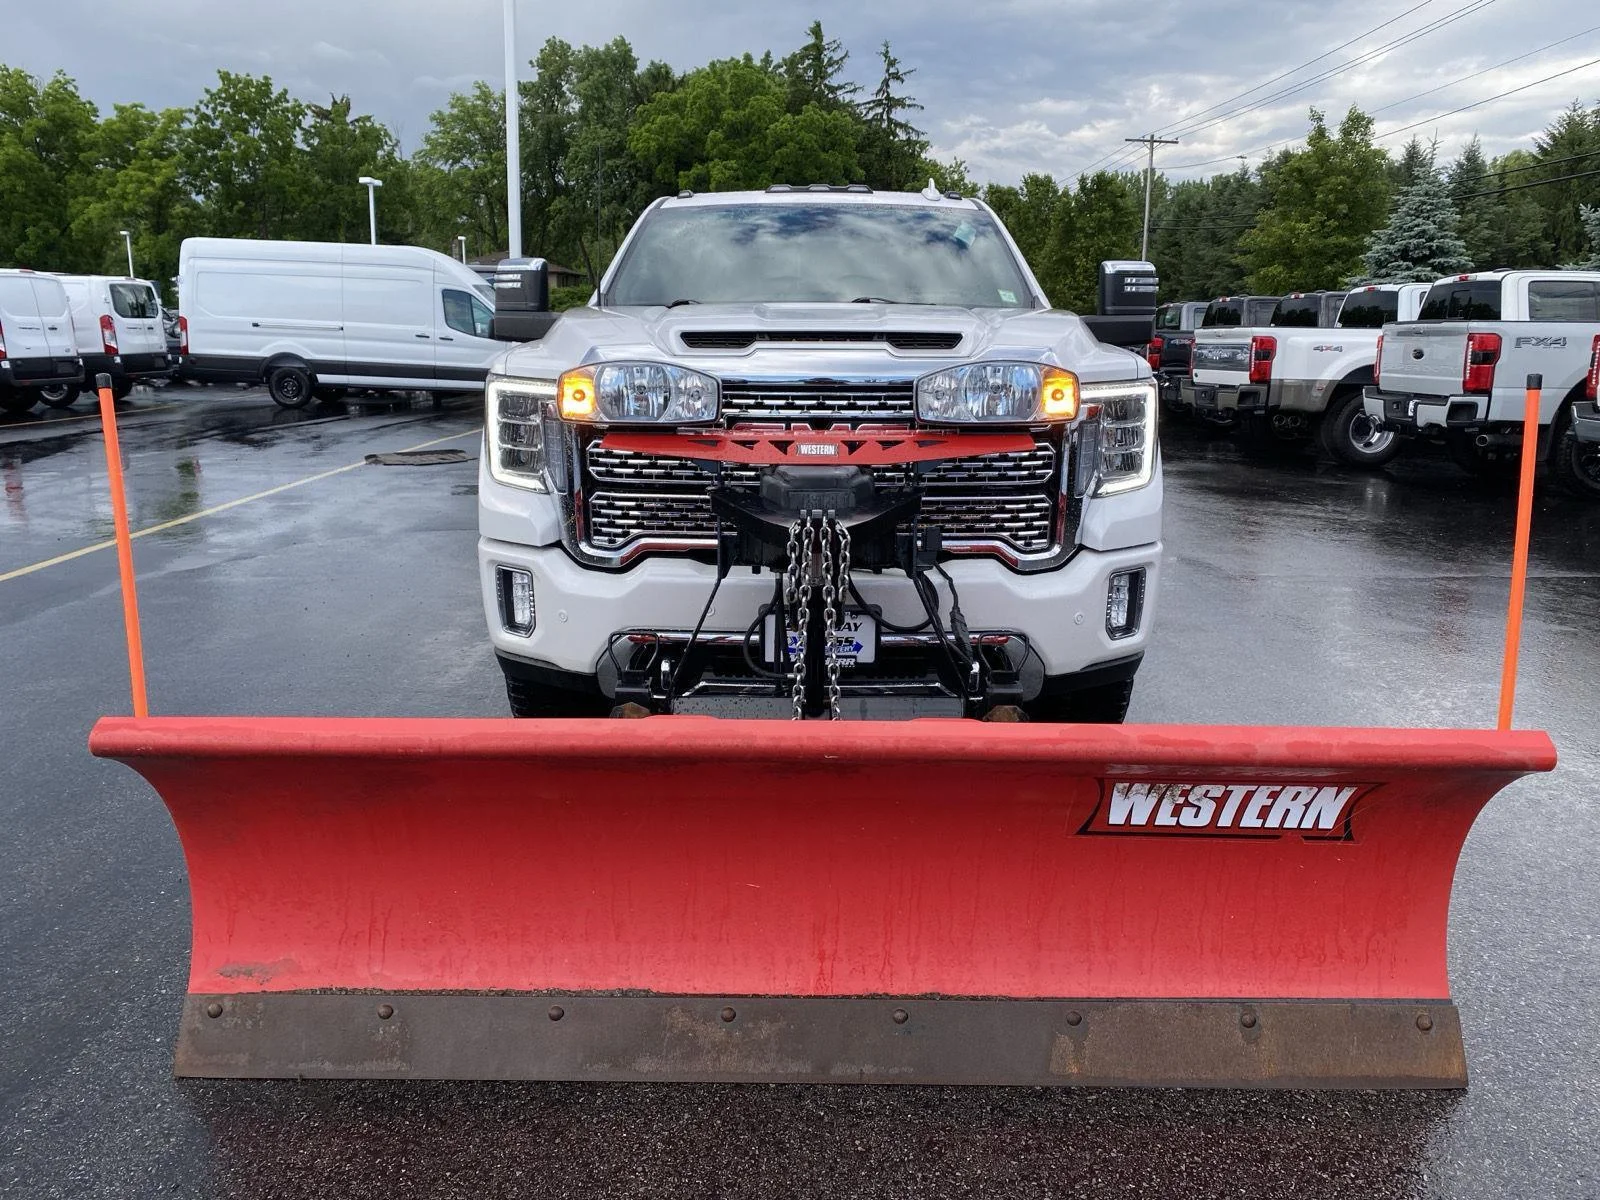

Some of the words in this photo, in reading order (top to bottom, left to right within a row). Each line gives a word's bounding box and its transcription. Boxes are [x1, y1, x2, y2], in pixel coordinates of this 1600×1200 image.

[1514, 336, 1567, 349] FX4
[1313, 345, 1343, 353] 4X4
[800, 444, 836, 456] WESTERN
[1107, 781, 1358, 830] WESTERN
